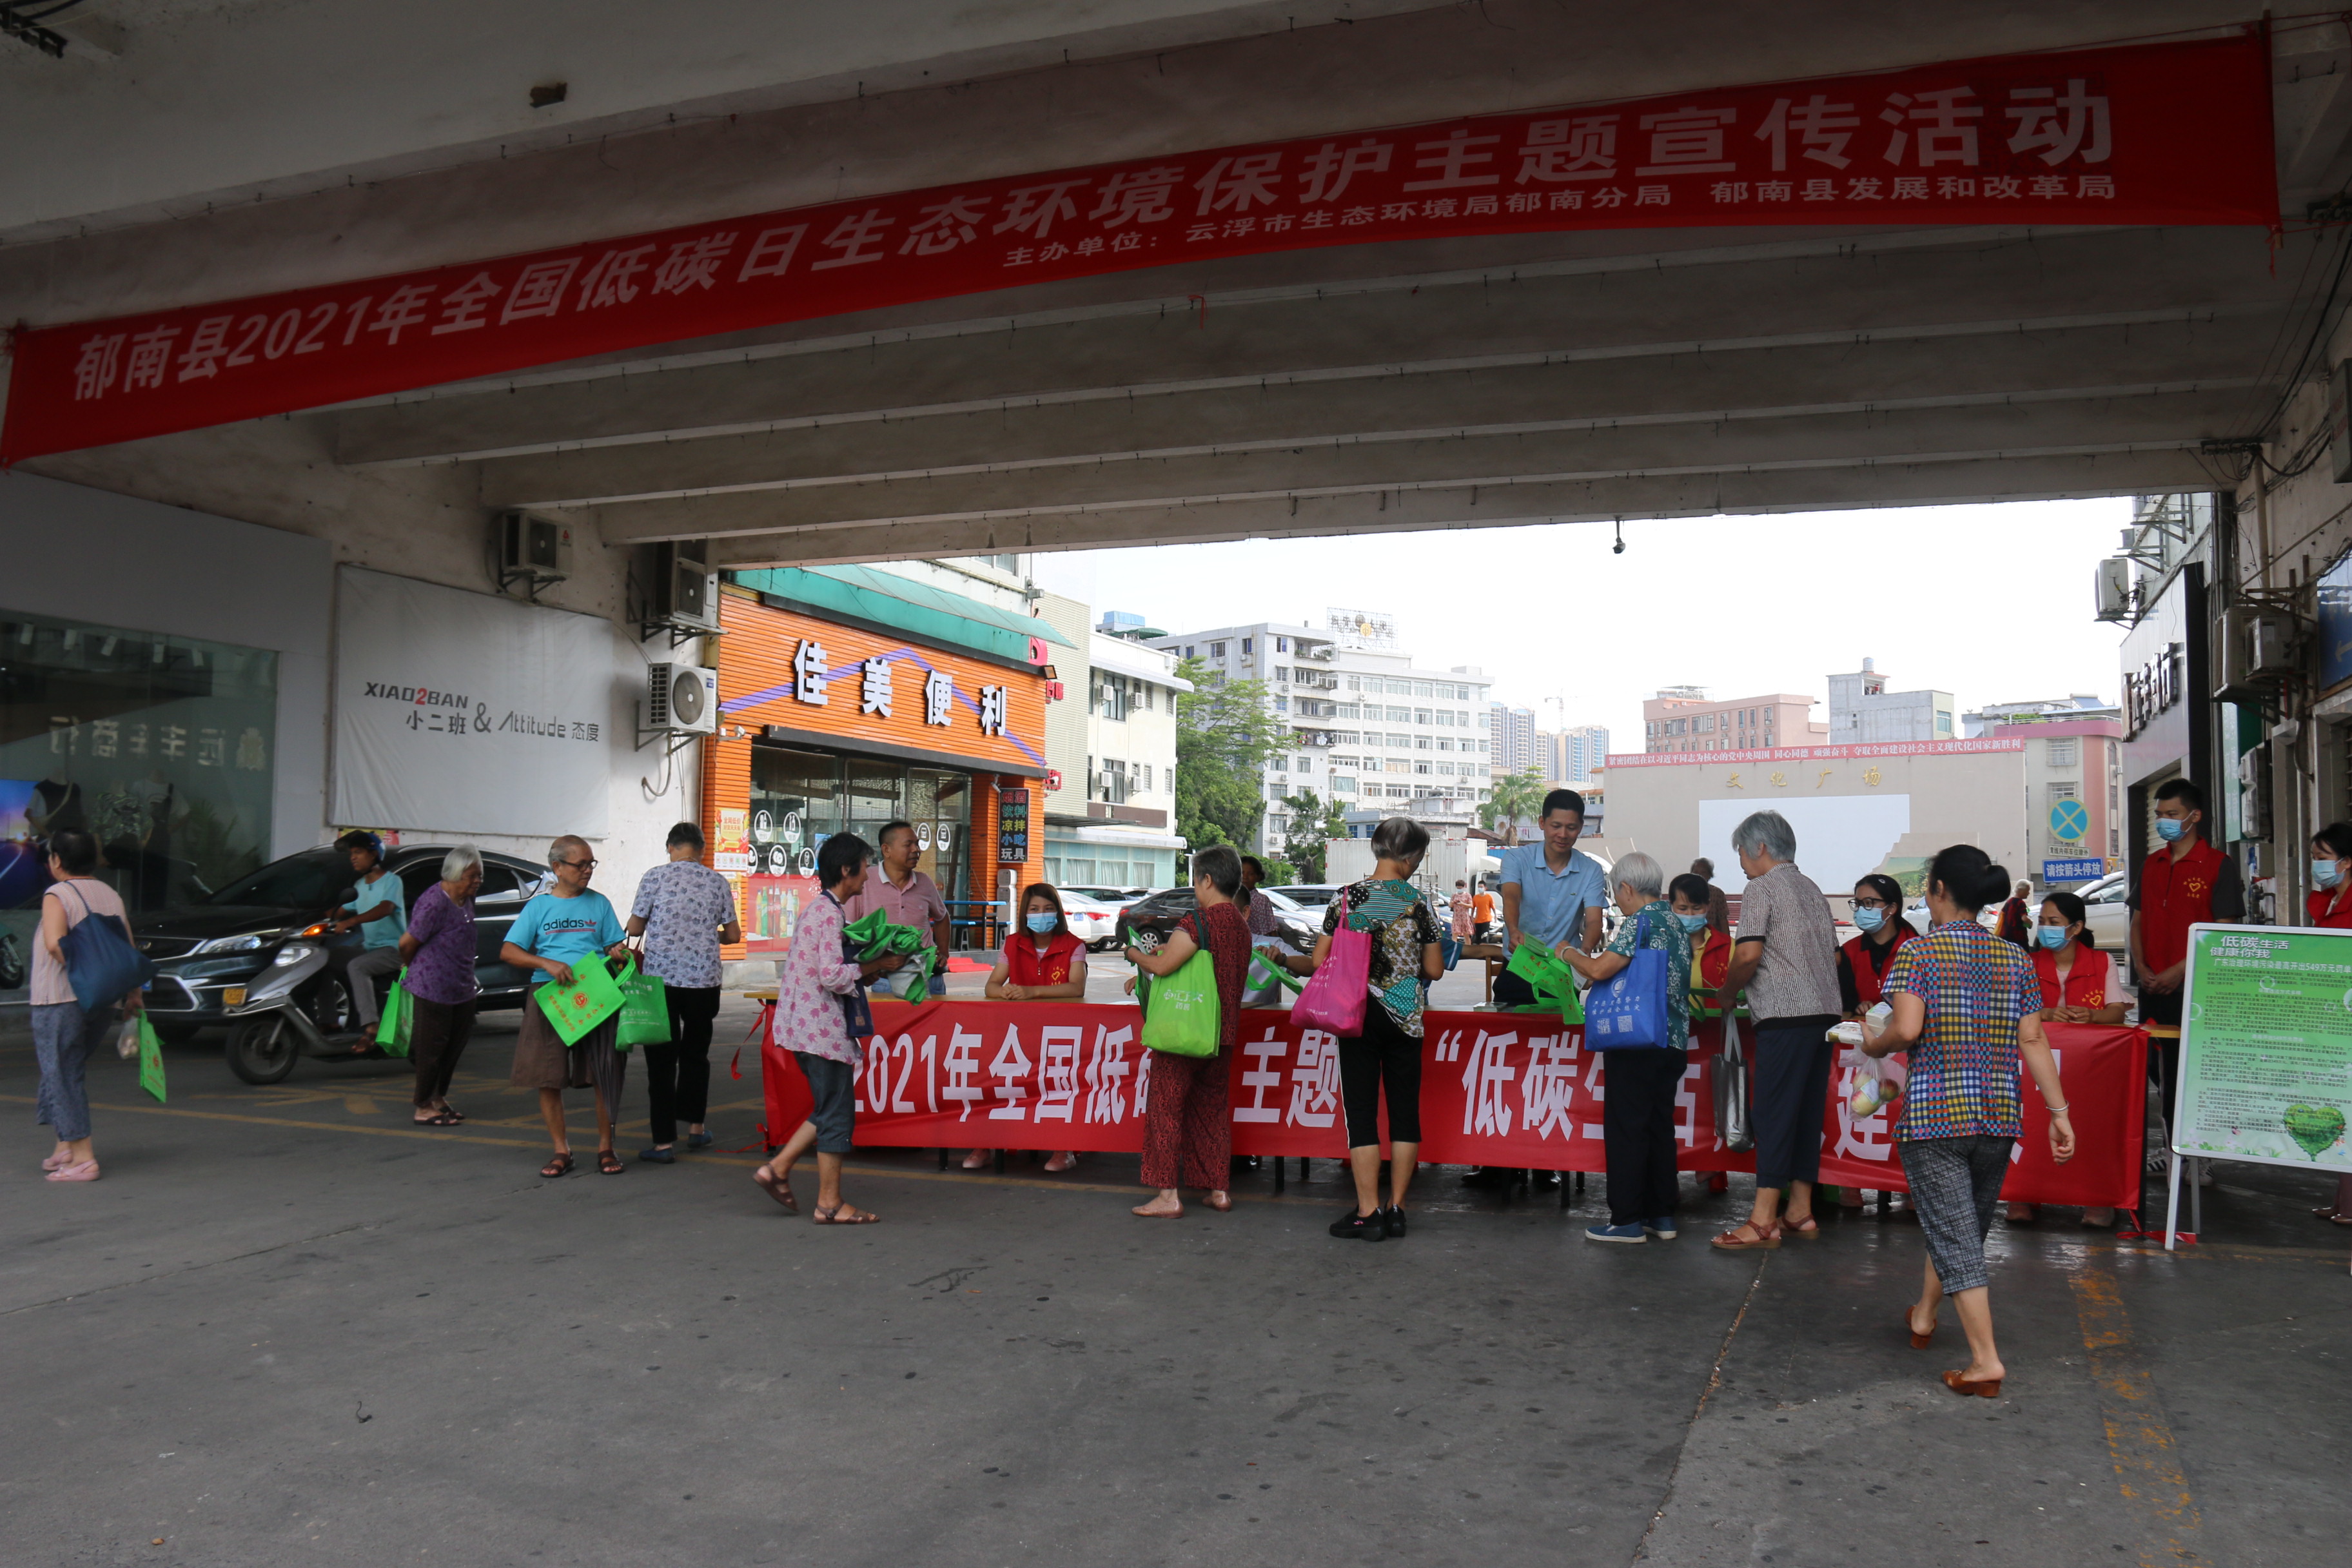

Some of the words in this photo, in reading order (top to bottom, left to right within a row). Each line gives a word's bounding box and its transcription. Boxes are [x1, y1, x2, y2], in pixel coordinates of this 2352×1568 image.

[1710, 174, 2117, 205] 郁南县发展和改革局
[792, 638, 1007, 736] 佳美便利
[406, 709, 466, 736] 小二班
[498, 710, 566, 739] Attitude
[571, 721, 600, 742] 态度
[1774, 748, 1809, 759] 同心同德
[1001, 791, 1026, 804] 烟酒
[1001, 805, 1027, 818] 饮料
[1001, 819, 1026, 832] 凉拌
[1001, 833, 1026, 846] 小吃
[1001, 848, 1025, 860] 玩具
[2046, 862, 2101, 877] 请按箭头停放
[543, 917, 585, 931] adidas
[2220, 935, 2289, 950] 低碳生活
[2210, 946, 2271, 959] 健康你我
